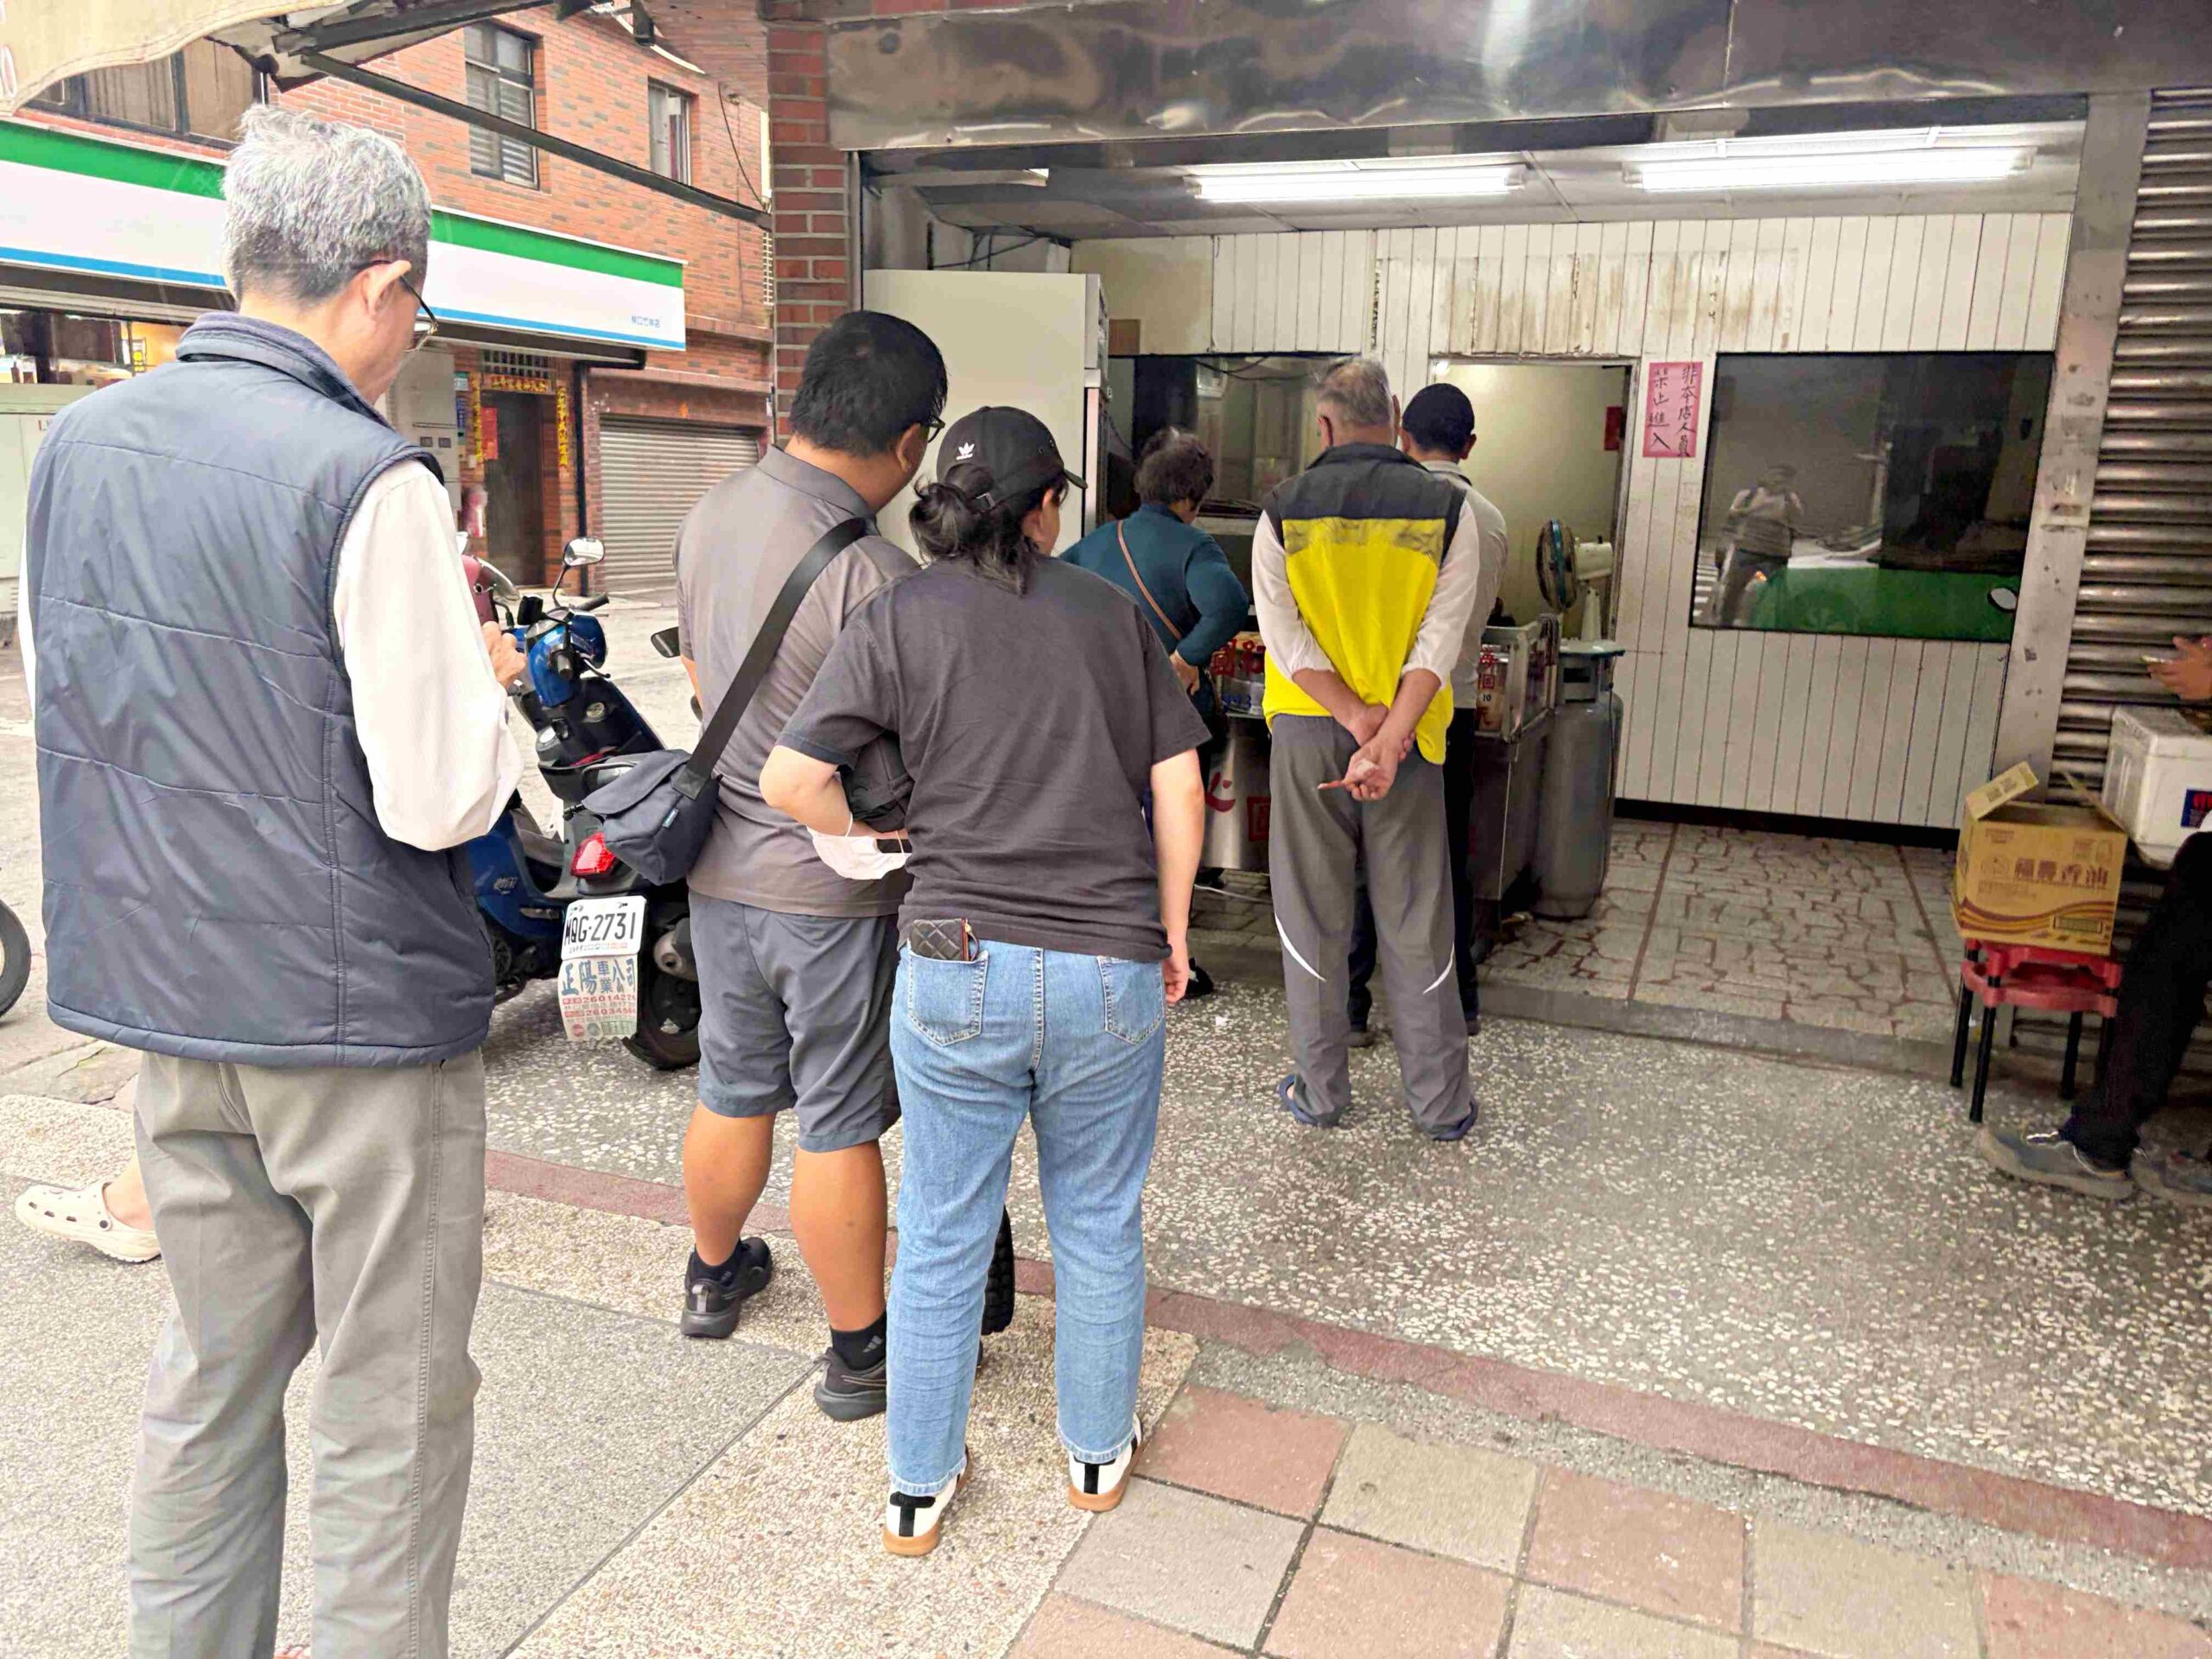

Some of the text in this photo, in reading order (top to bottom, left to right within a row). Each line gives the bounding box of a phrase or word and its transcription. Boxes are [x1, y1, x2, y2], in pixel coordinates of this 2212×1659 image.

[1647, 367, 1671, 450] 禁止進入
[1676, 364, 1699, 457] 非本店人員
[562, 958, 636, 996] 正陽車業公司
